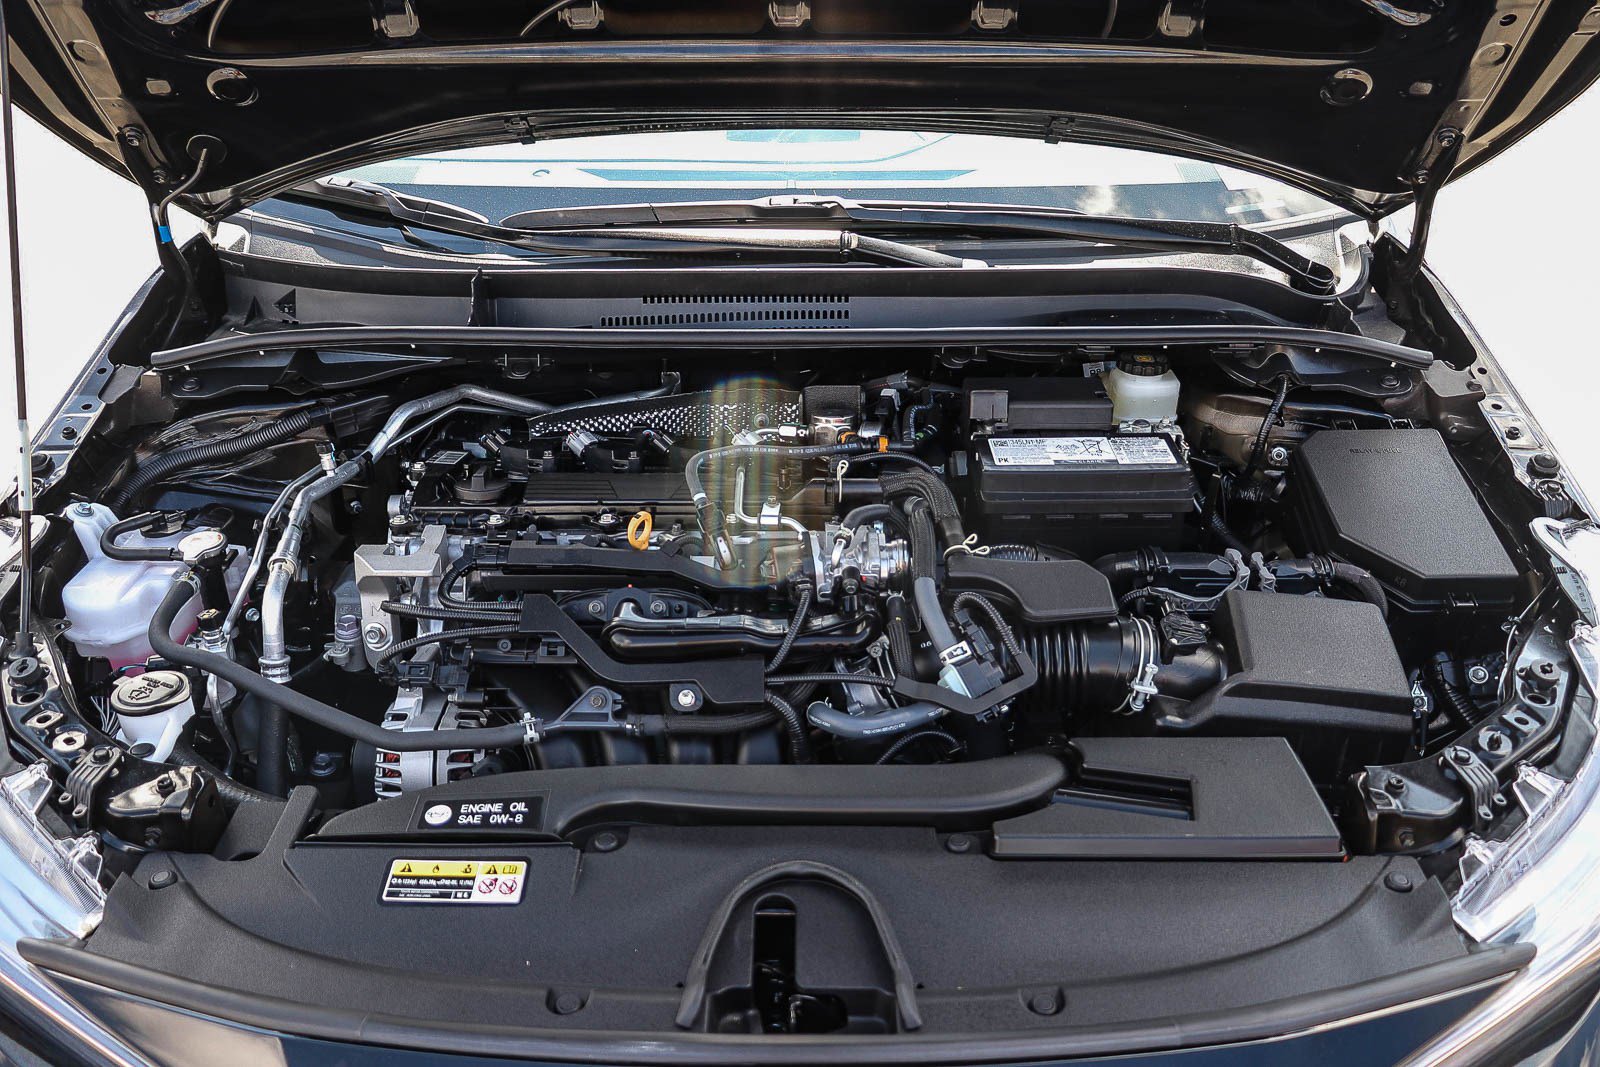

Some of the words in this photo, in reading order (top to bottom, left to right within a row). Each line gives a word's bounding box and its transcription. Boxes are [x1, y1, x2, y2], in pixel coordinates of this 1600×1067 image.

[460, 803, 504, 814] ENGINE
[509, 801, 529, 813] OIL
[457, 814, 482, 824] SAE
[489, 813, 523, 825] 0W-8
